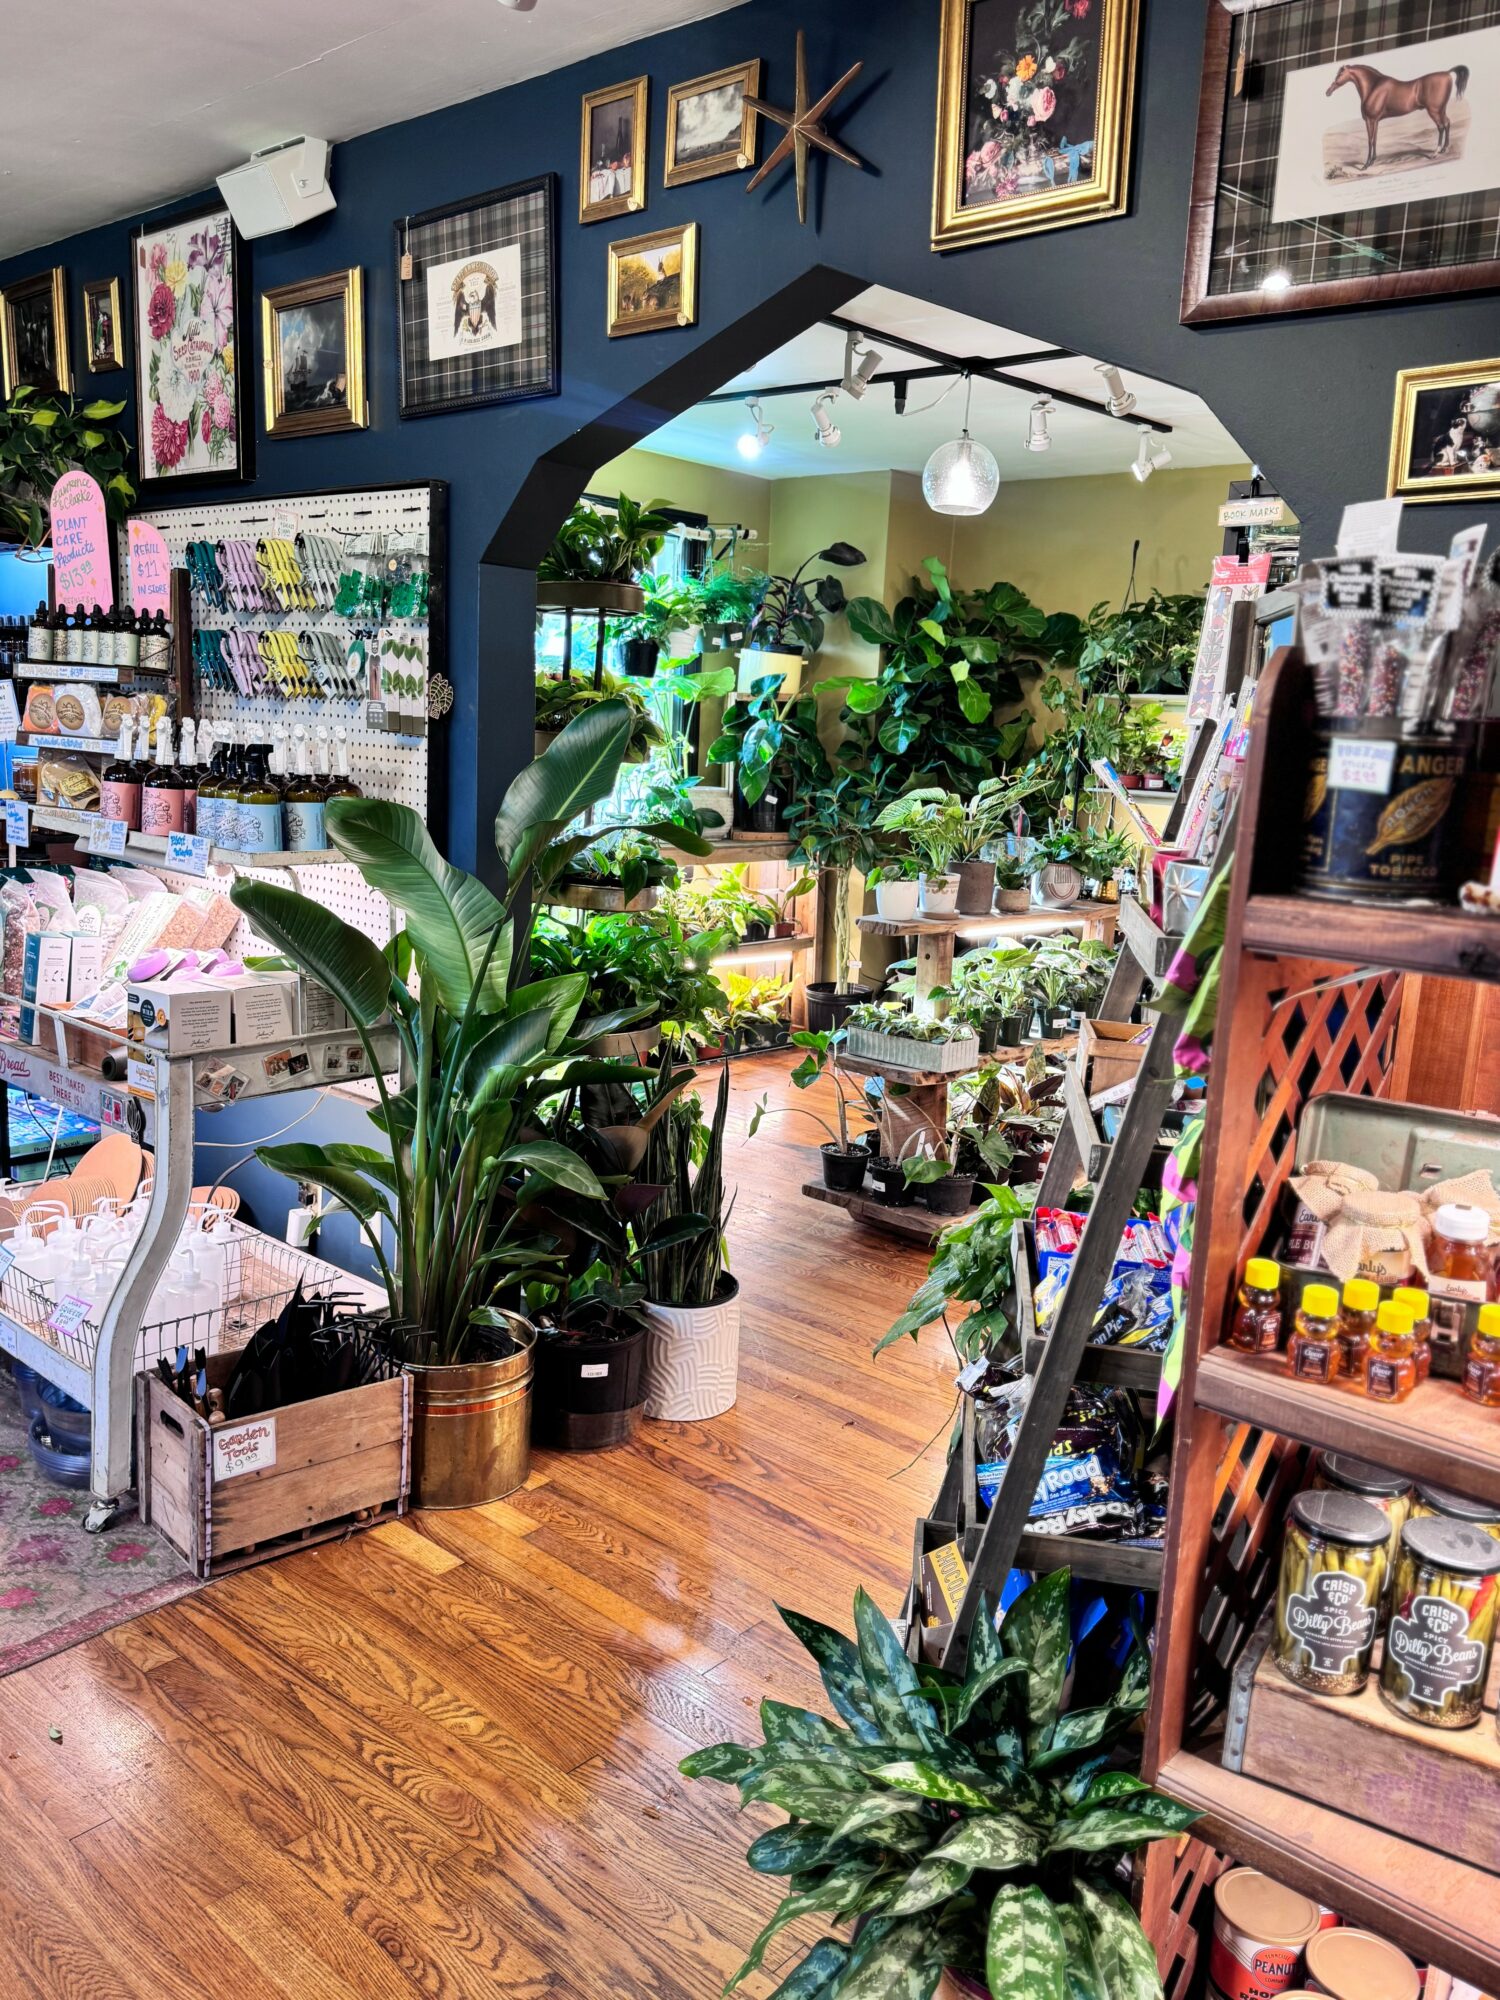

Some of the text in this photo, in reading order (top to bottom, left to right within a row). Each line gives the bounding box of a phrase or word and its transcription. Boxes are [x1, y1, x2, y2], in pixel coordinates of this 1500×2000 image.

[1224, 506, 1280, 521] BOOK MARKS
[56, 517, 87, 531] PLANT
[56, 532, 83, 546] CARE
[55, 540, 95, 568] Products
[133, 544, 160, 557] REFILL
[137, 560, 160, 578] $11
[1329, 573, 1373, 583] Chocolate
[1380, 574, 1432, 590] Chocolate
[137, 584, 168, 595] IN STORE
[1333, 583, 1365, 594] Pretzel
[1384, 586, 1422, 600] Pretzel
[1400, 754, 1466, 775] ANGER
[1390, 854, 1424, 865] PIPE
[1369, 864, 1438, 877] TOBACCO
[49, 1070, 63, 1084] BEST
[53, 1086, 72, 1102] THERE
[1358, 1260, 1387, 1276] arly's
[1104, 1314, 1124, 1339] Pie
[1304, 1349, 1324, 1359] Clover
[219, 1427, 270, 1450] Garden
[223, 1442, 259, 1461] Tools
[1066, 1501, 1137, 1526] Rocky
[1322, 1580, 1357, 1595] CRISP
[1324, 1606, 1348, 1615] SPICY
[1422, 1604, 1458, 1624] CRISP
[1293, 1607, 1372, 1637] Dilly Beans
[1423, 1632, 1449, 1644] SPICY
[1395, 1630, 1478, 1666] Dilly Beans
